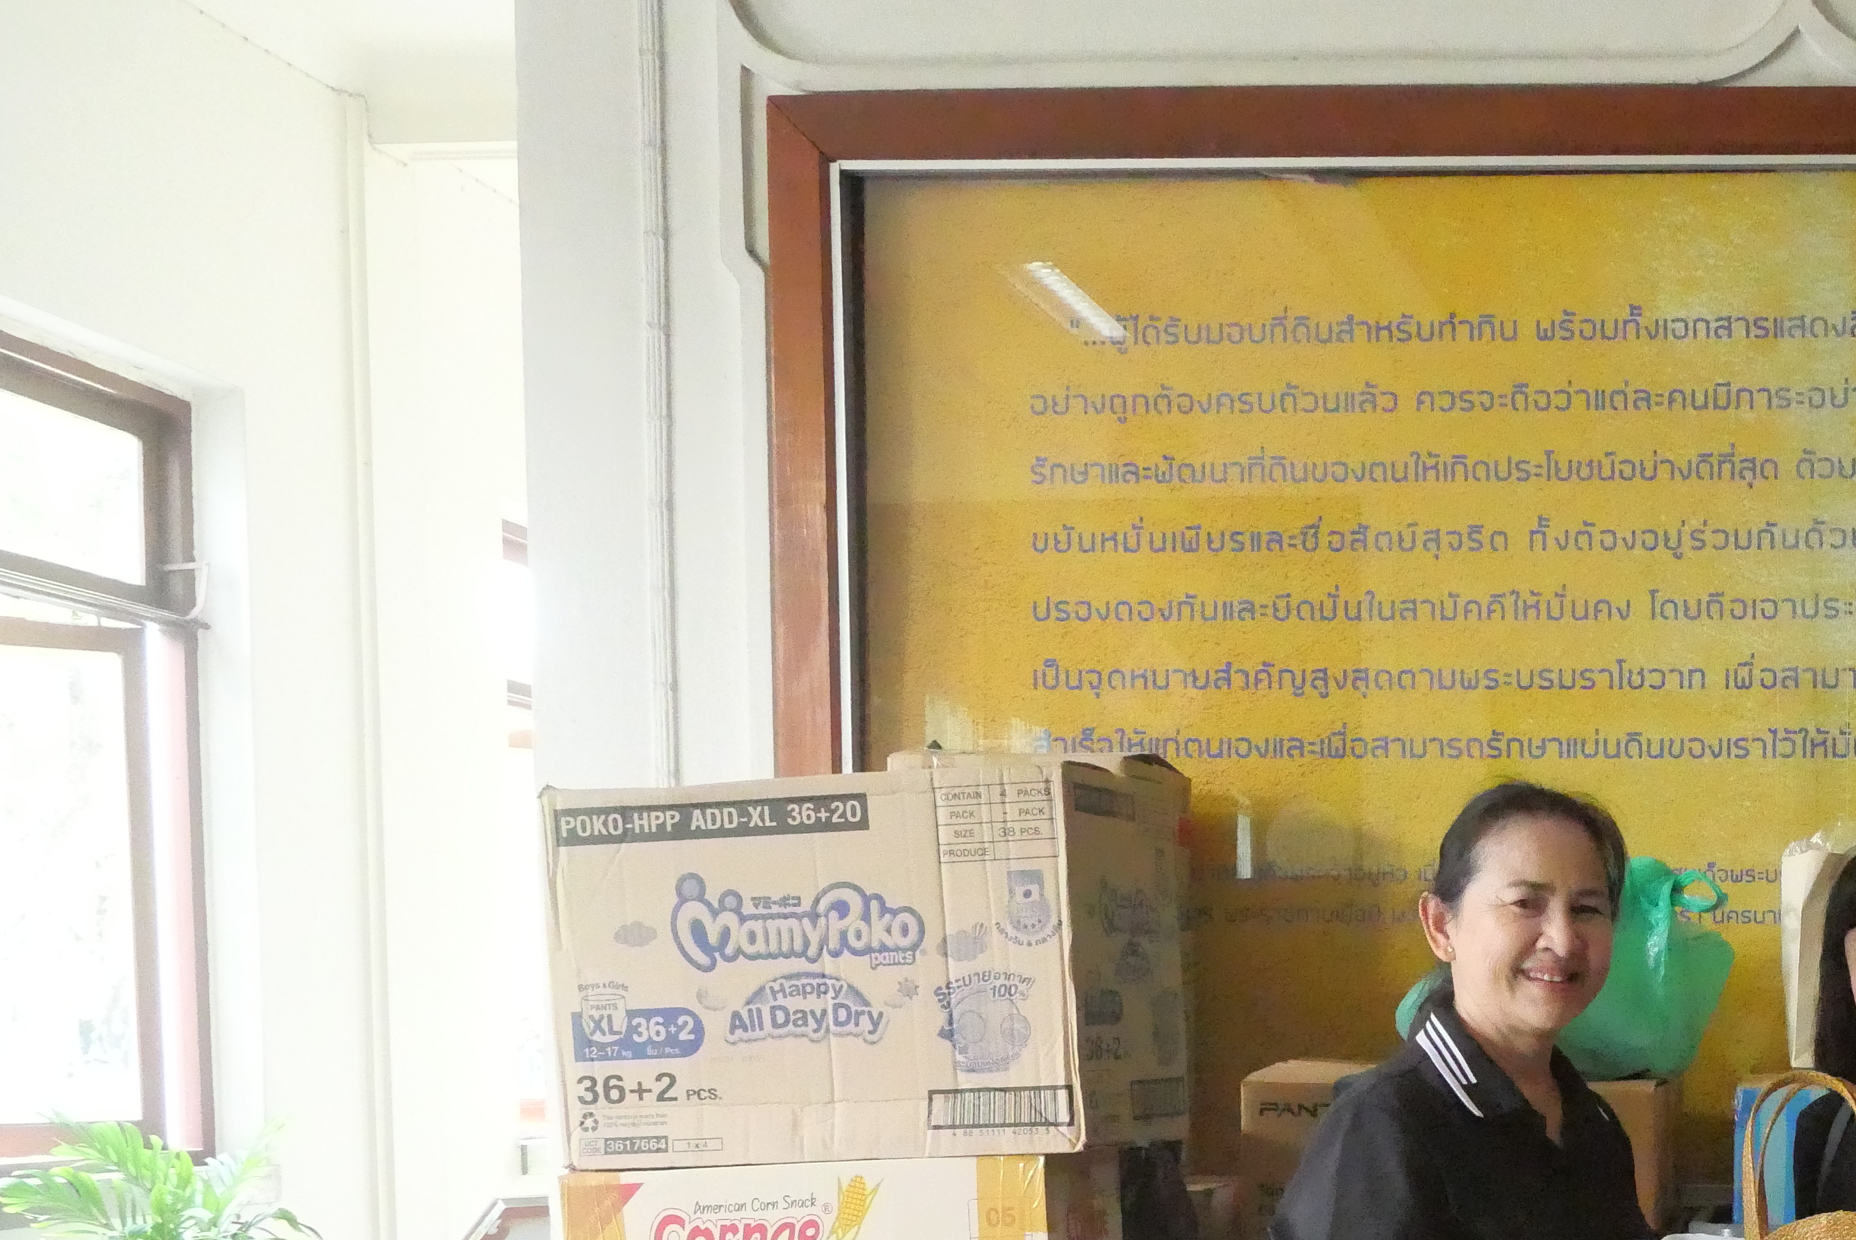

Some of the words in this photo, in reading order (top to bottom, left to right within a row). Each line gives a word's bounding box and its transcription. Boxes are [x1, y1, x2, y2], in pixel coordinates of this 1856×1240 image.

[1030, 380, 1399, 424] อย่างถูกต้องครบถ้วนแล้ว
[940, 791, 982, 801] CONTAIN
[1017, 787, 1050, 798] PACKS
[560, 810, 680, 838] POKO-HPP
[690, 806, 777, 831] ADD-XL
[786, 800, 862, 824] 36+20
[949, 810, 976, 820] PACK
[1018, 807, 1045, 817] PACK
[953, 829, 975, 839] SIZE
[998, 827, 1016, 837] 38
[1020, 827, 1043, 837] PCS.
[943, 848, 990, 858] PRODUCE
[673, 880, 924, 970] MamyPoko
[870, 952, 915, 969] pants
[769, 977, 844, 1002] Happy
[589, 1014, 623, 1037] XL
[632, 1015, 695, 1042] 36+2
[729, 1006, 764, 1036] All
[769, 1003, 826, 1036] Day
[832, 1002, 883, 1036] Dry
[576, 1072, 678, 1106] 36+2
[686, 1088, 722, 1101] PCS.
[607, 1139, 666, 1152] 3617664
[694, 1201, 747, 1215] American
[752, 1198, 779, 1212] Corn
[782, 1192, 817, 1210] Snack
